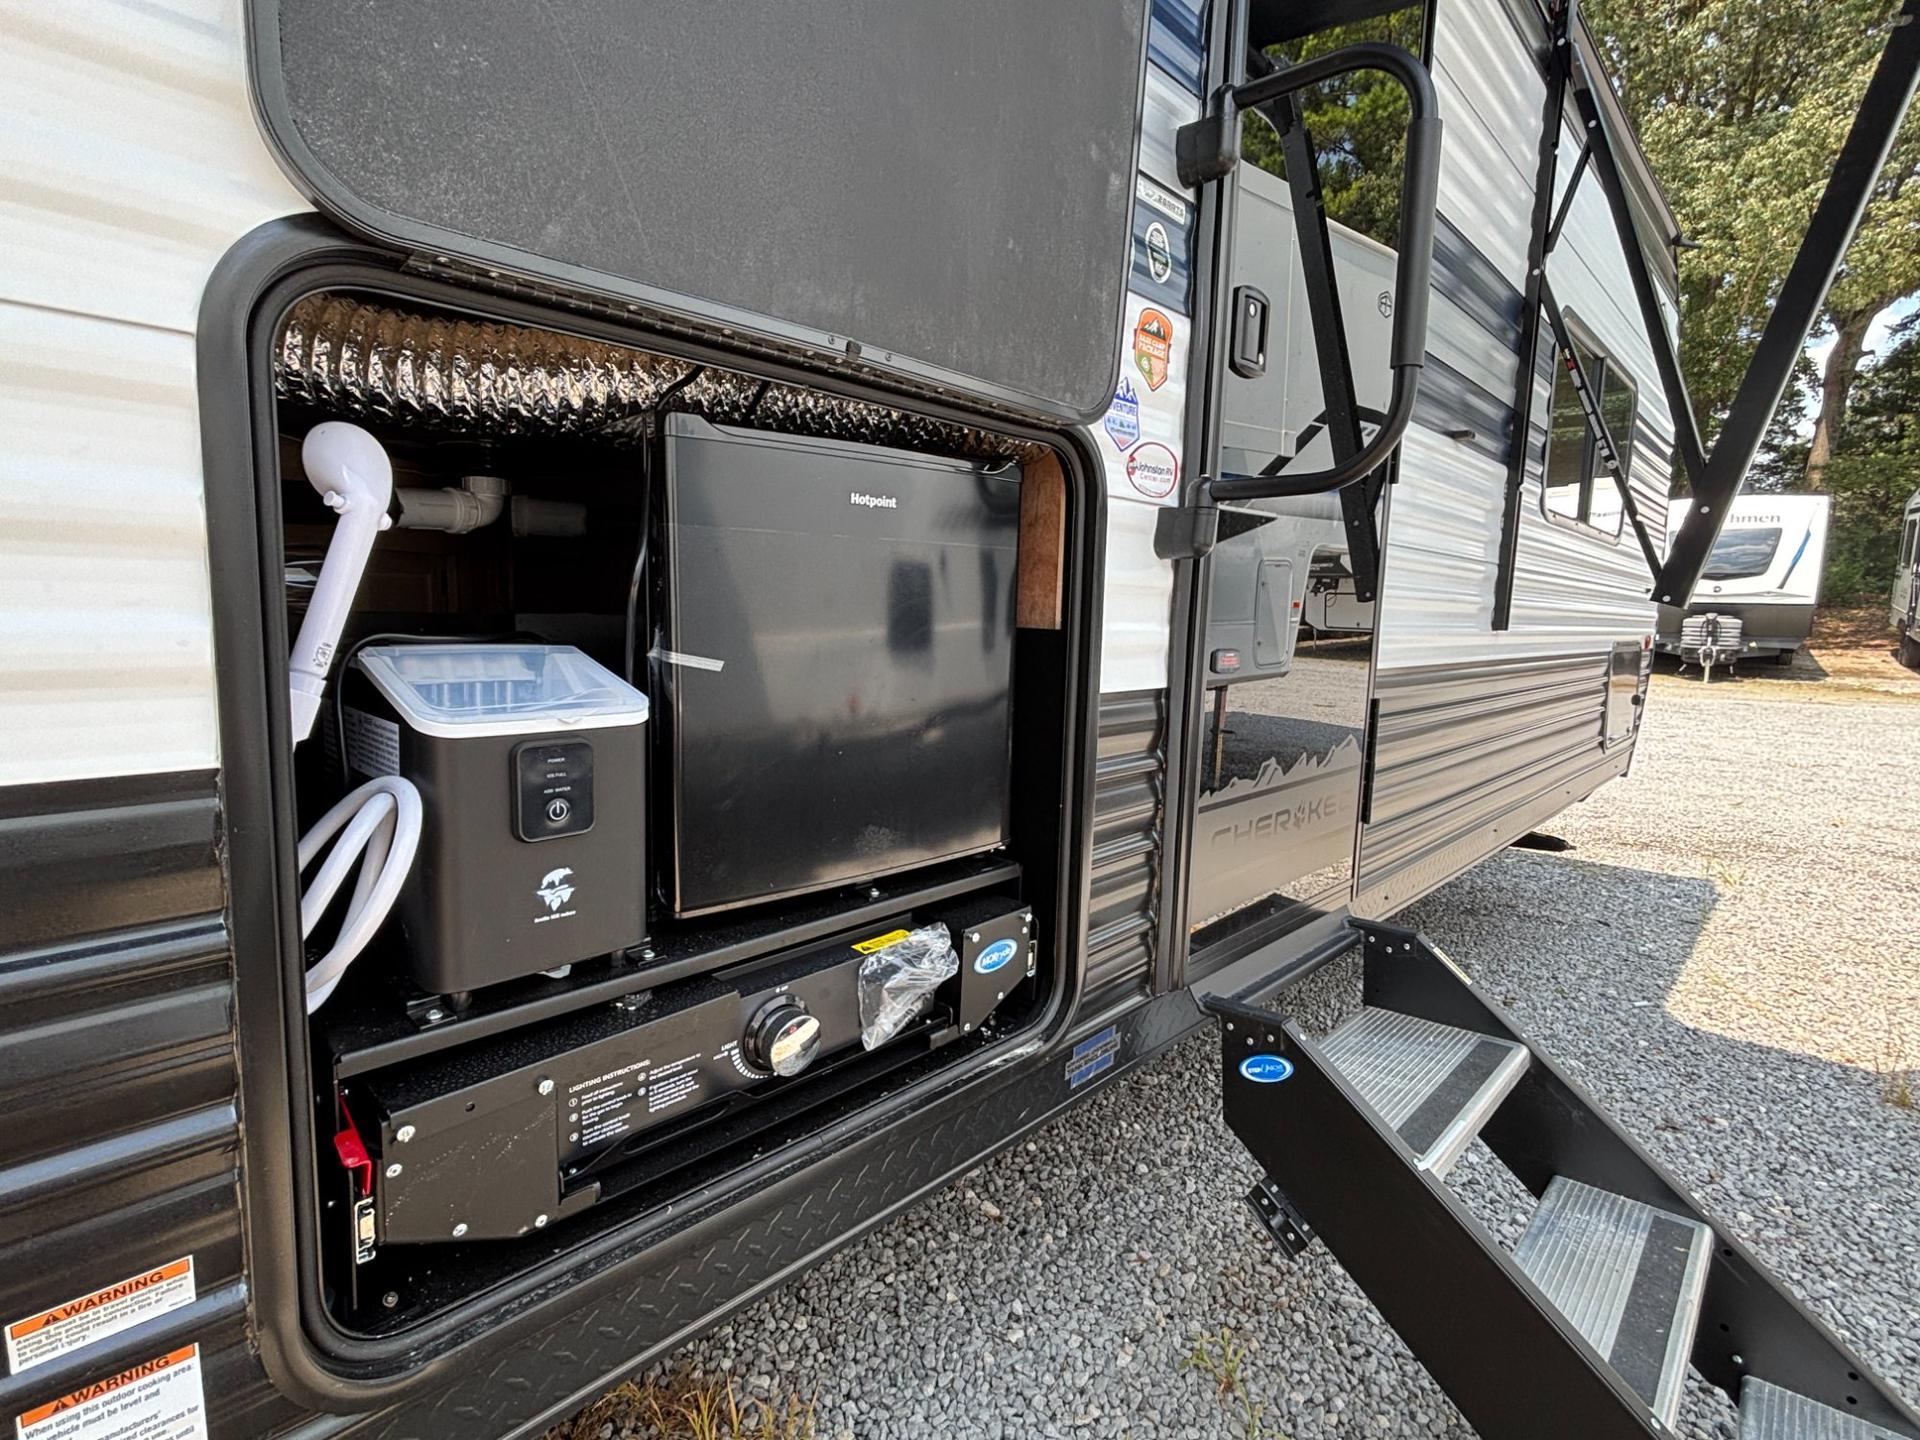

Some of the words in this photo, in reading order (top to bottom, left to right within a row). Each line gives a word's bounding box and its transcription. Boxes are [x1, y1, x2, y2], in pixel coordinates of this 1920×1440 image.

[850, 492, 897, 508] Hotpoint
[1730, 513, 1781, 524] hmen
[721, 1040, 738, 1051] LIGHT
[568, 1076, 602, 1094] LIGHTING
[62, 1272, 164, 1316] WARNING
[72, 1356, 170, 1403] WARNING
[25, 1423, 53, 1440] When
[55, 1412, 80, 1428] using
[83, 1403, 99, 1415] this
[102, 1388, 135, 1408] outdoor
[138, 1373, 171, 1392] cooking
[82, 1412, 105, 1428] must
[107, 1408, 118, 1417] be
[120, 1396, 142, 1411] level
[144, 1388, 160, 1401] and
[140, 1411, 186, 1436] clearances
[187, 1405, 199, 1414] for
[176, 1425, 194, 1440] until
